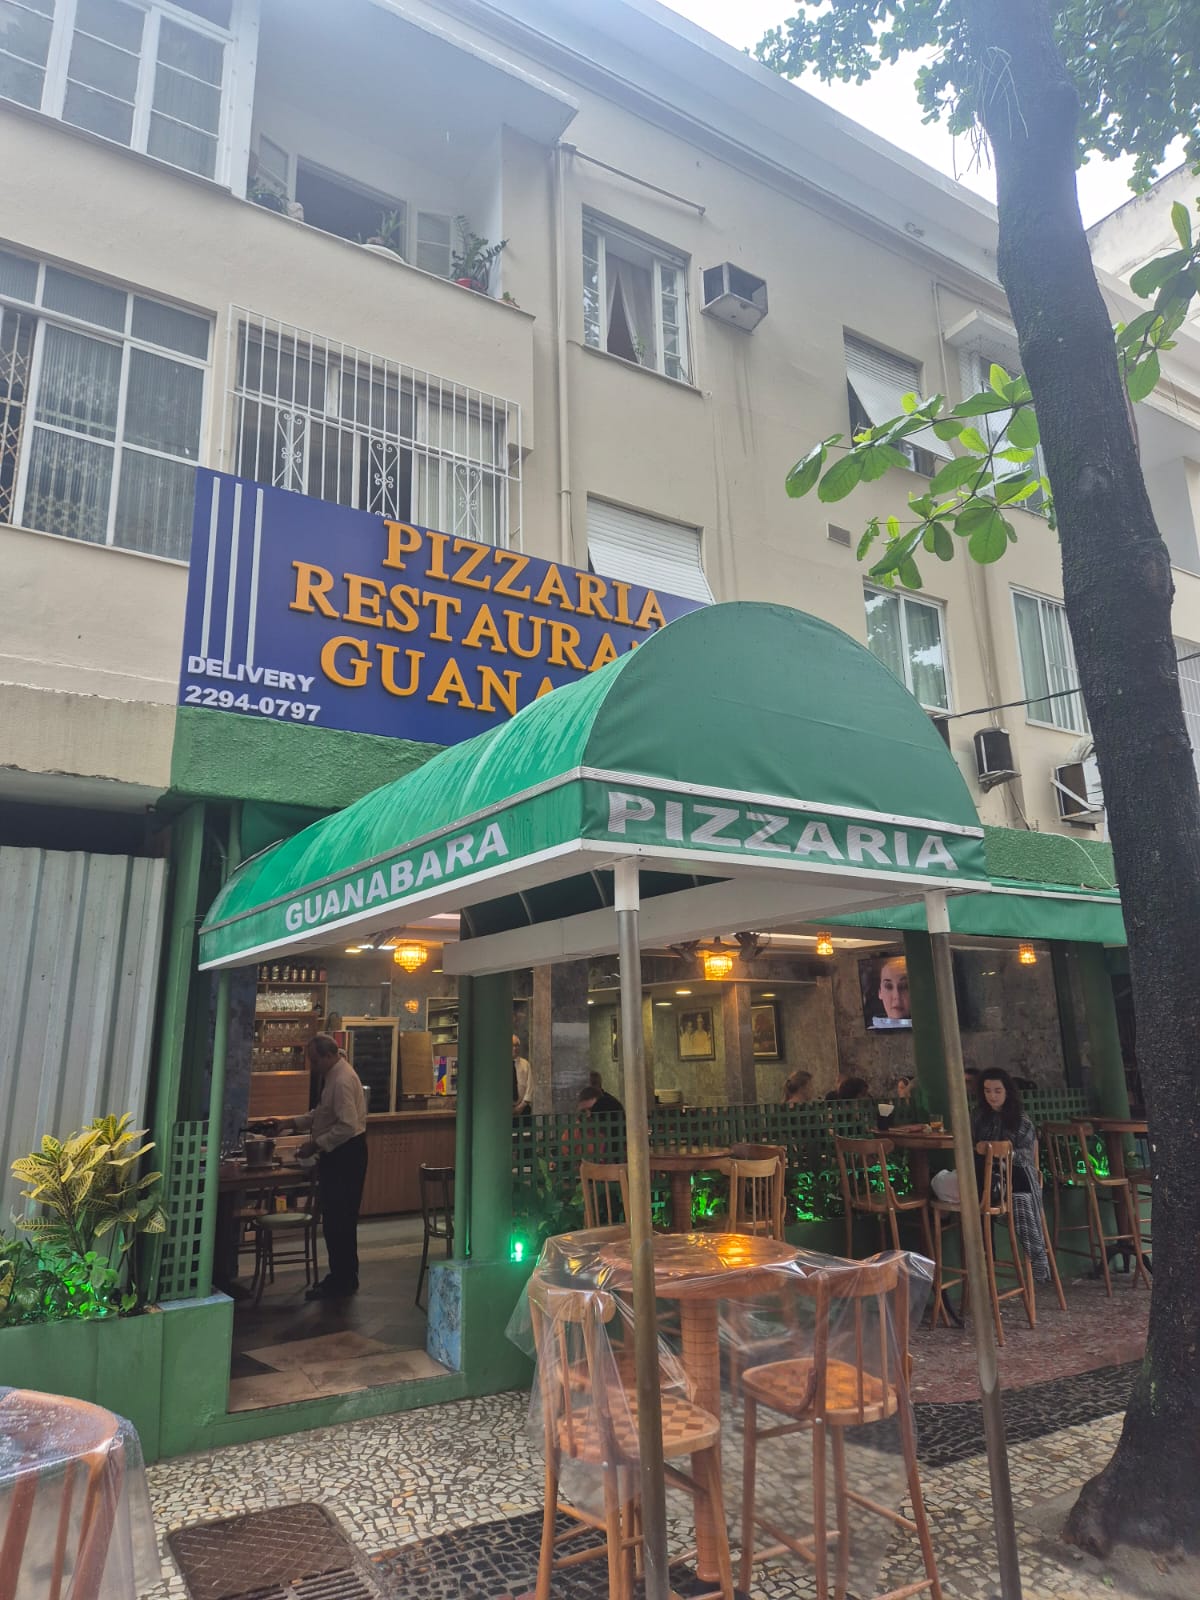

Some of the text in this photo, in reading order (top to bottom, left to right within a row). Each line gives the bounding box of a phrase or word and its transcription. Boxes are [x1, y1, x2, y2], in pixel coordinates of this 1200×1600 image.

[289, 560, 640, 673] RESTAURA
[383, 519, 667, 630] PIZZARIA
[184, 685, 321, 722] 2294-0797
[187, 655, 315, 692] DELIVERY
[284, 821, 510, 933] GUANABARA
[606, 790, 958, 872] PIZZARIA
